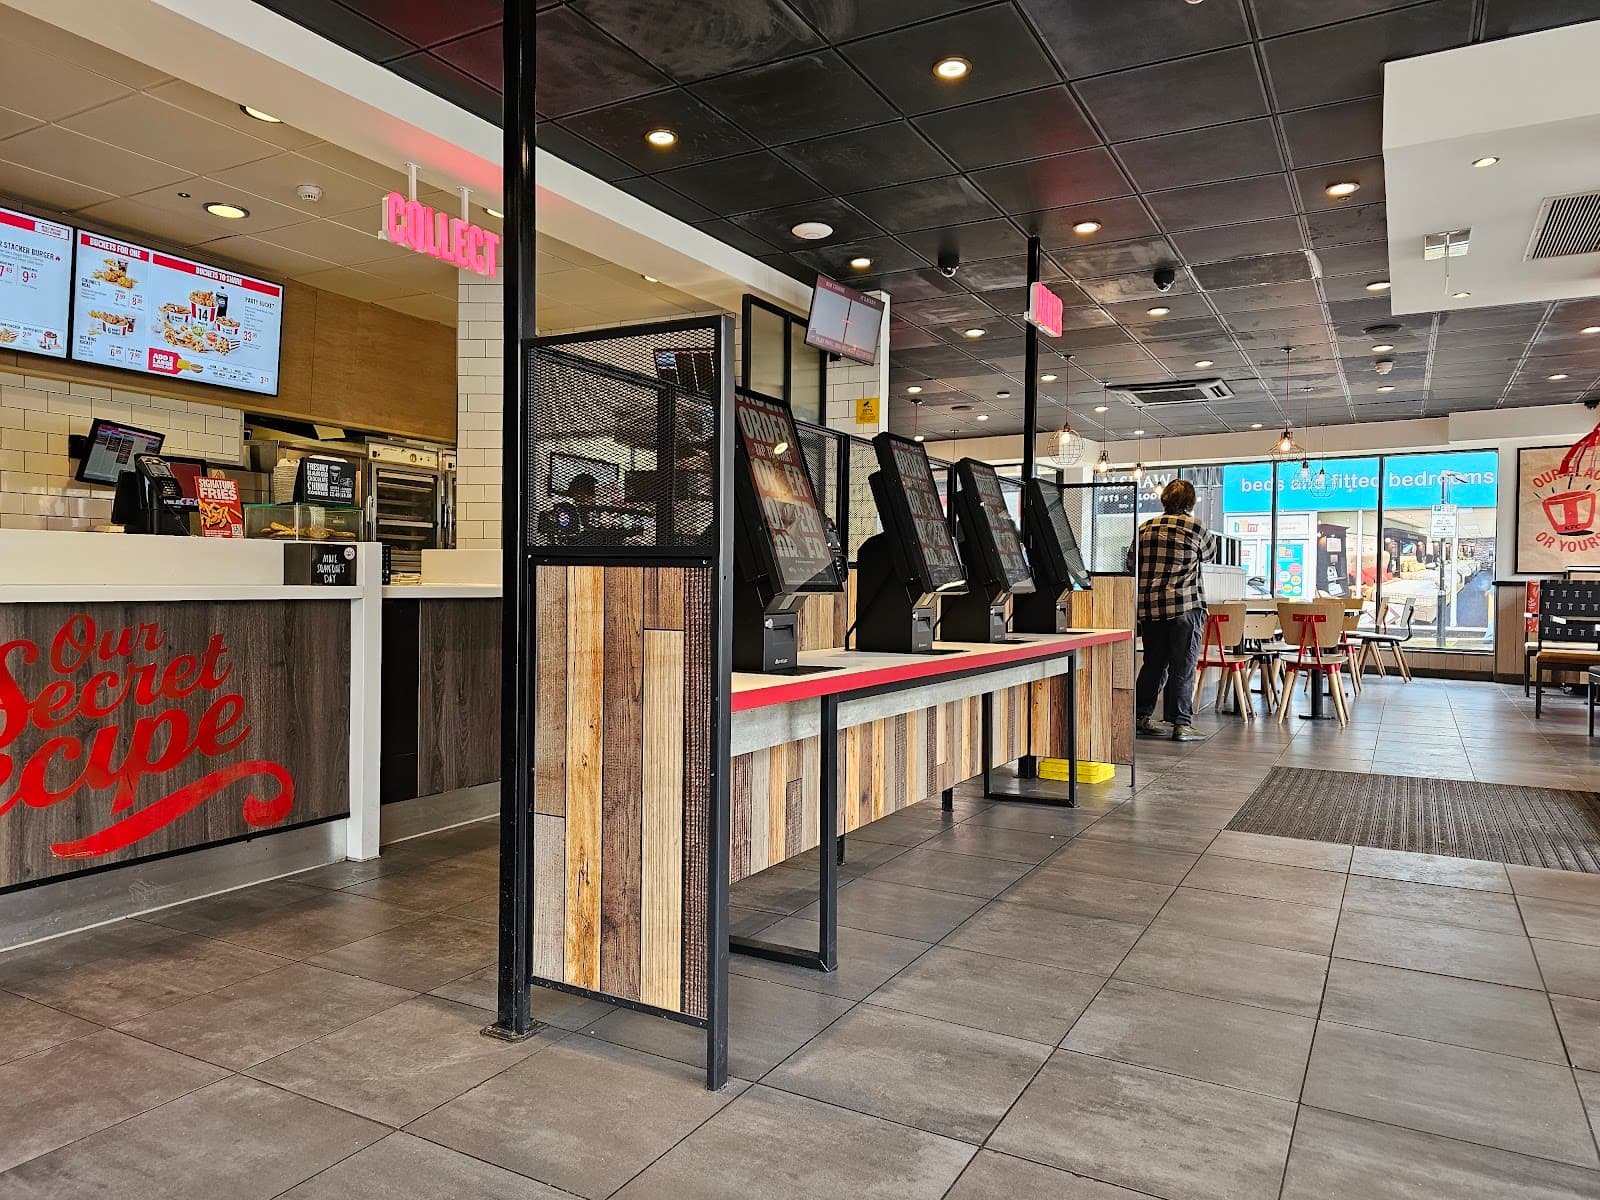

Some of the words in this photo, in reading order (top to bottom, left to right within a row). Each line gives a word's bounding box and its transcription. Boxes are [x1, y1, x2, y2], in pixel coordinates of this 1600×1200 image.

[386, 191, 500, 278] COLLECT
[4, 241, 30, 255] STACKER
[31, 248, 55, 260] BURGER
[90, 238, 117, 252] BUCKETS
[117, 245, 129, 255] FOR
[129, 248, 142, 259] ONE
[195, 266, 218, 279] BUCKETS
[218, 272, 227, 282] TO
[197, 308, 209, 321] 14
[738, 405, 794, 450] ORDER
[306, 462, 329, 473] FRESHLY
[306, 469, 329, 478] BAKED
[198, 478, 236, 491] SIGNATURE
[307, 480, 329, 492] CHUNK
[754, 457, 809, 498] ORER
[1241, 477, 1286, 493] beds
[1331, 471, 1380, 492] fitted
[199, 487, 238, 501] FRIES
[1535, 531, 1556, 549] OR
[323, 573, 337, 584] DAY
[51, 613, 166, 674] Our
[0, 634, 233, 750] Secret
